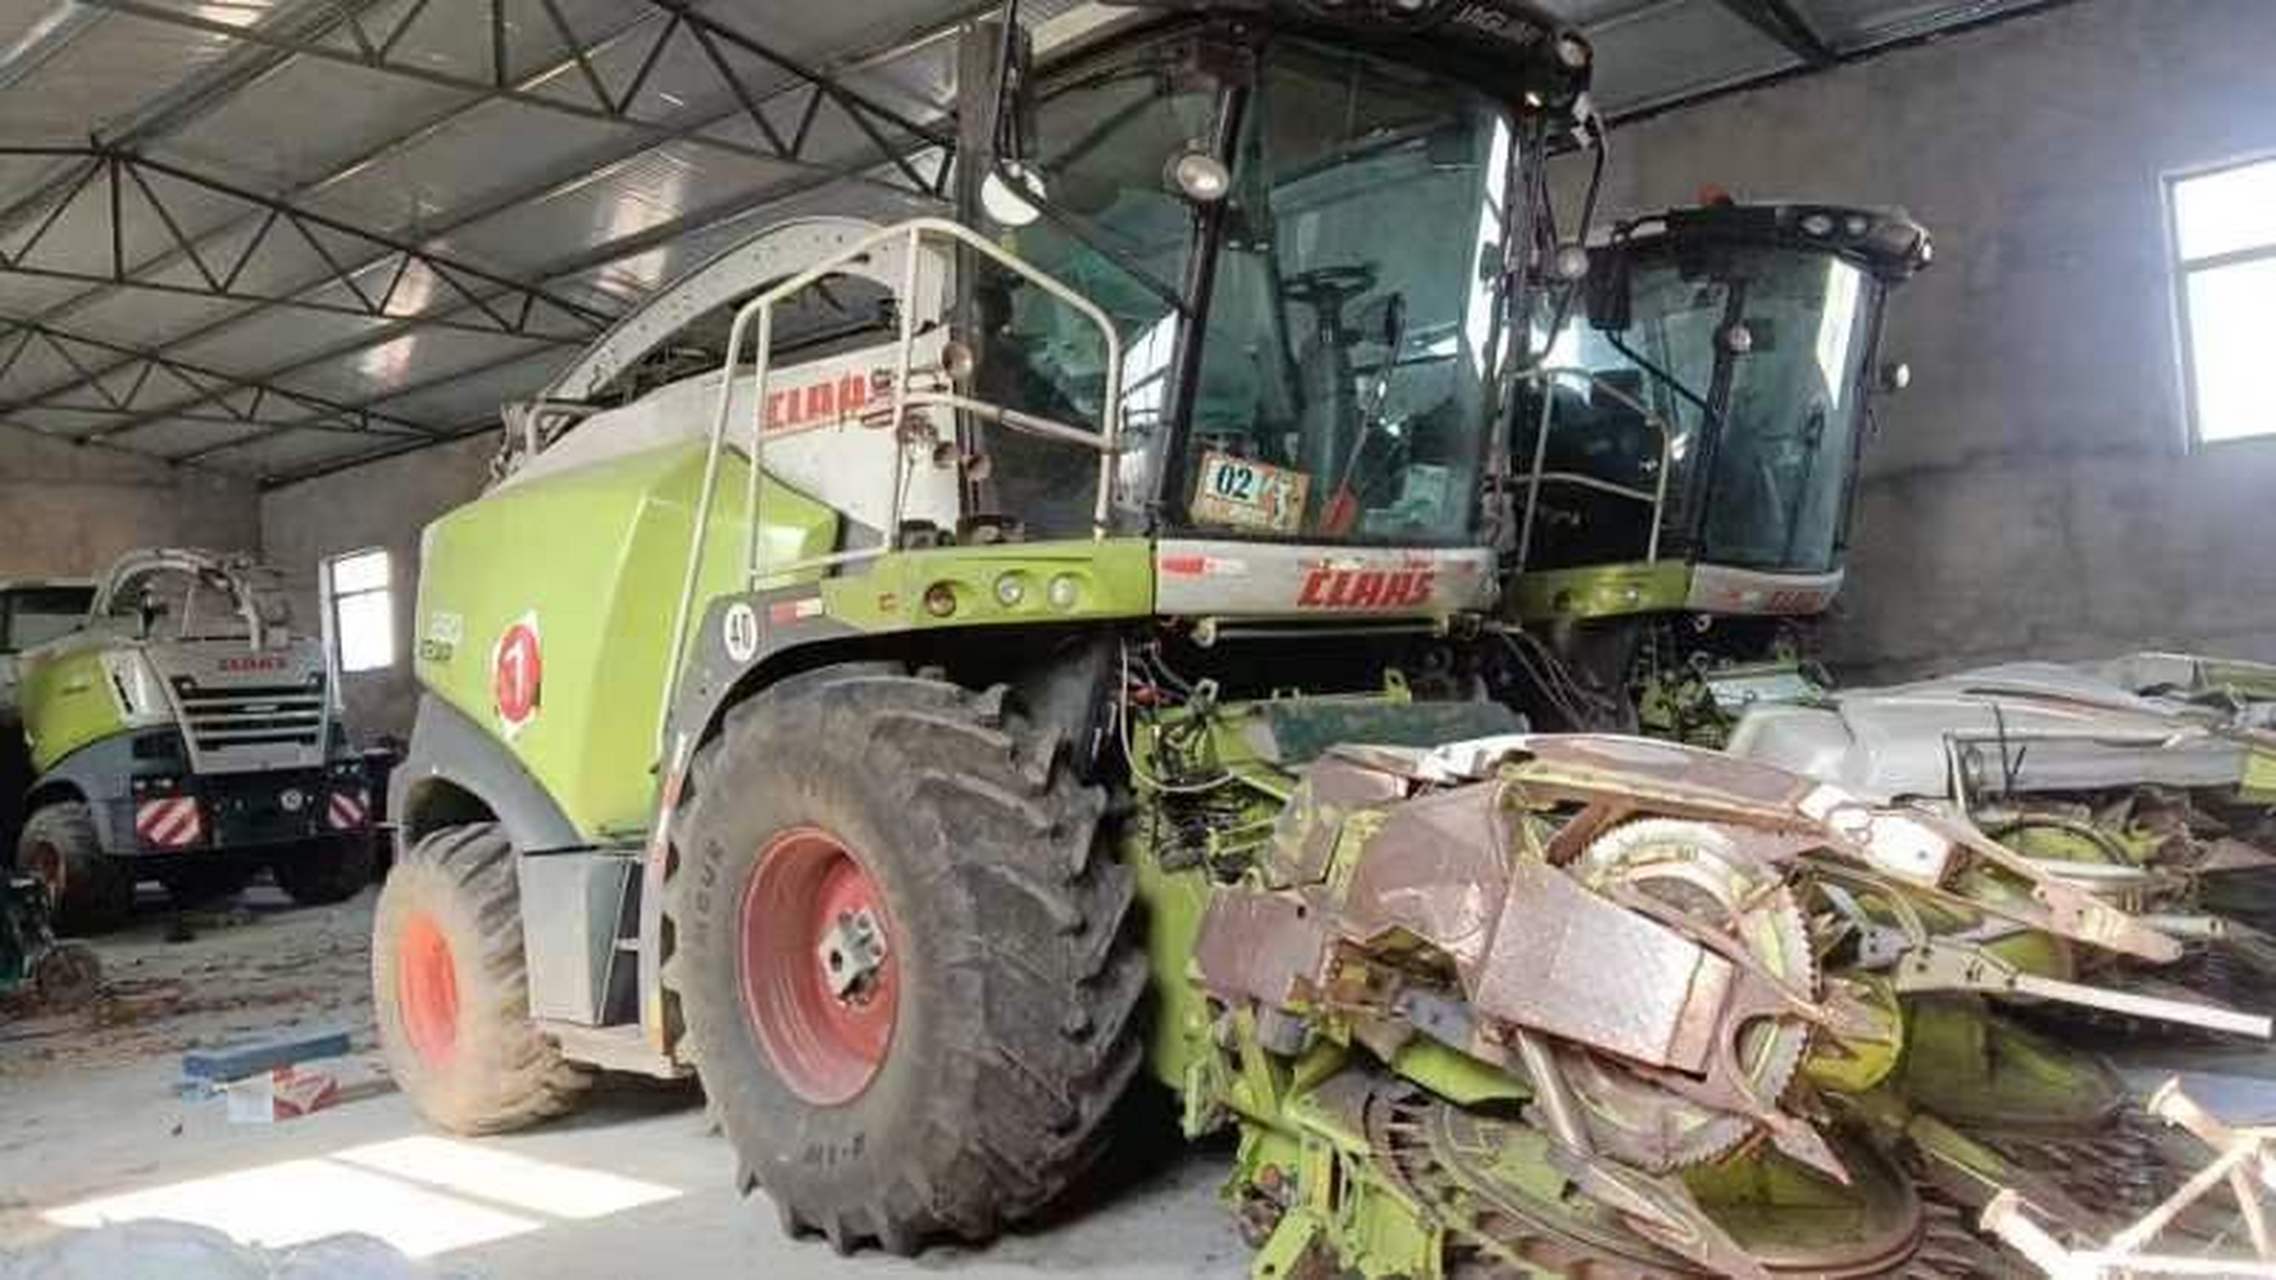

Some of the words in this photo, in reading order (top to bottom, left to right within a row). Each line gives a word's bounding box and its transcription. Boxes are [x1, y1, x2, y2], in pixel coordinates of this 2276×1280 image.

[1217, 465, 1252, 499] 02
[1298, 569, 1435, 609] CLAAS
[730, 611, 752, 647] 40
[504, 638, 525, 706] 1
